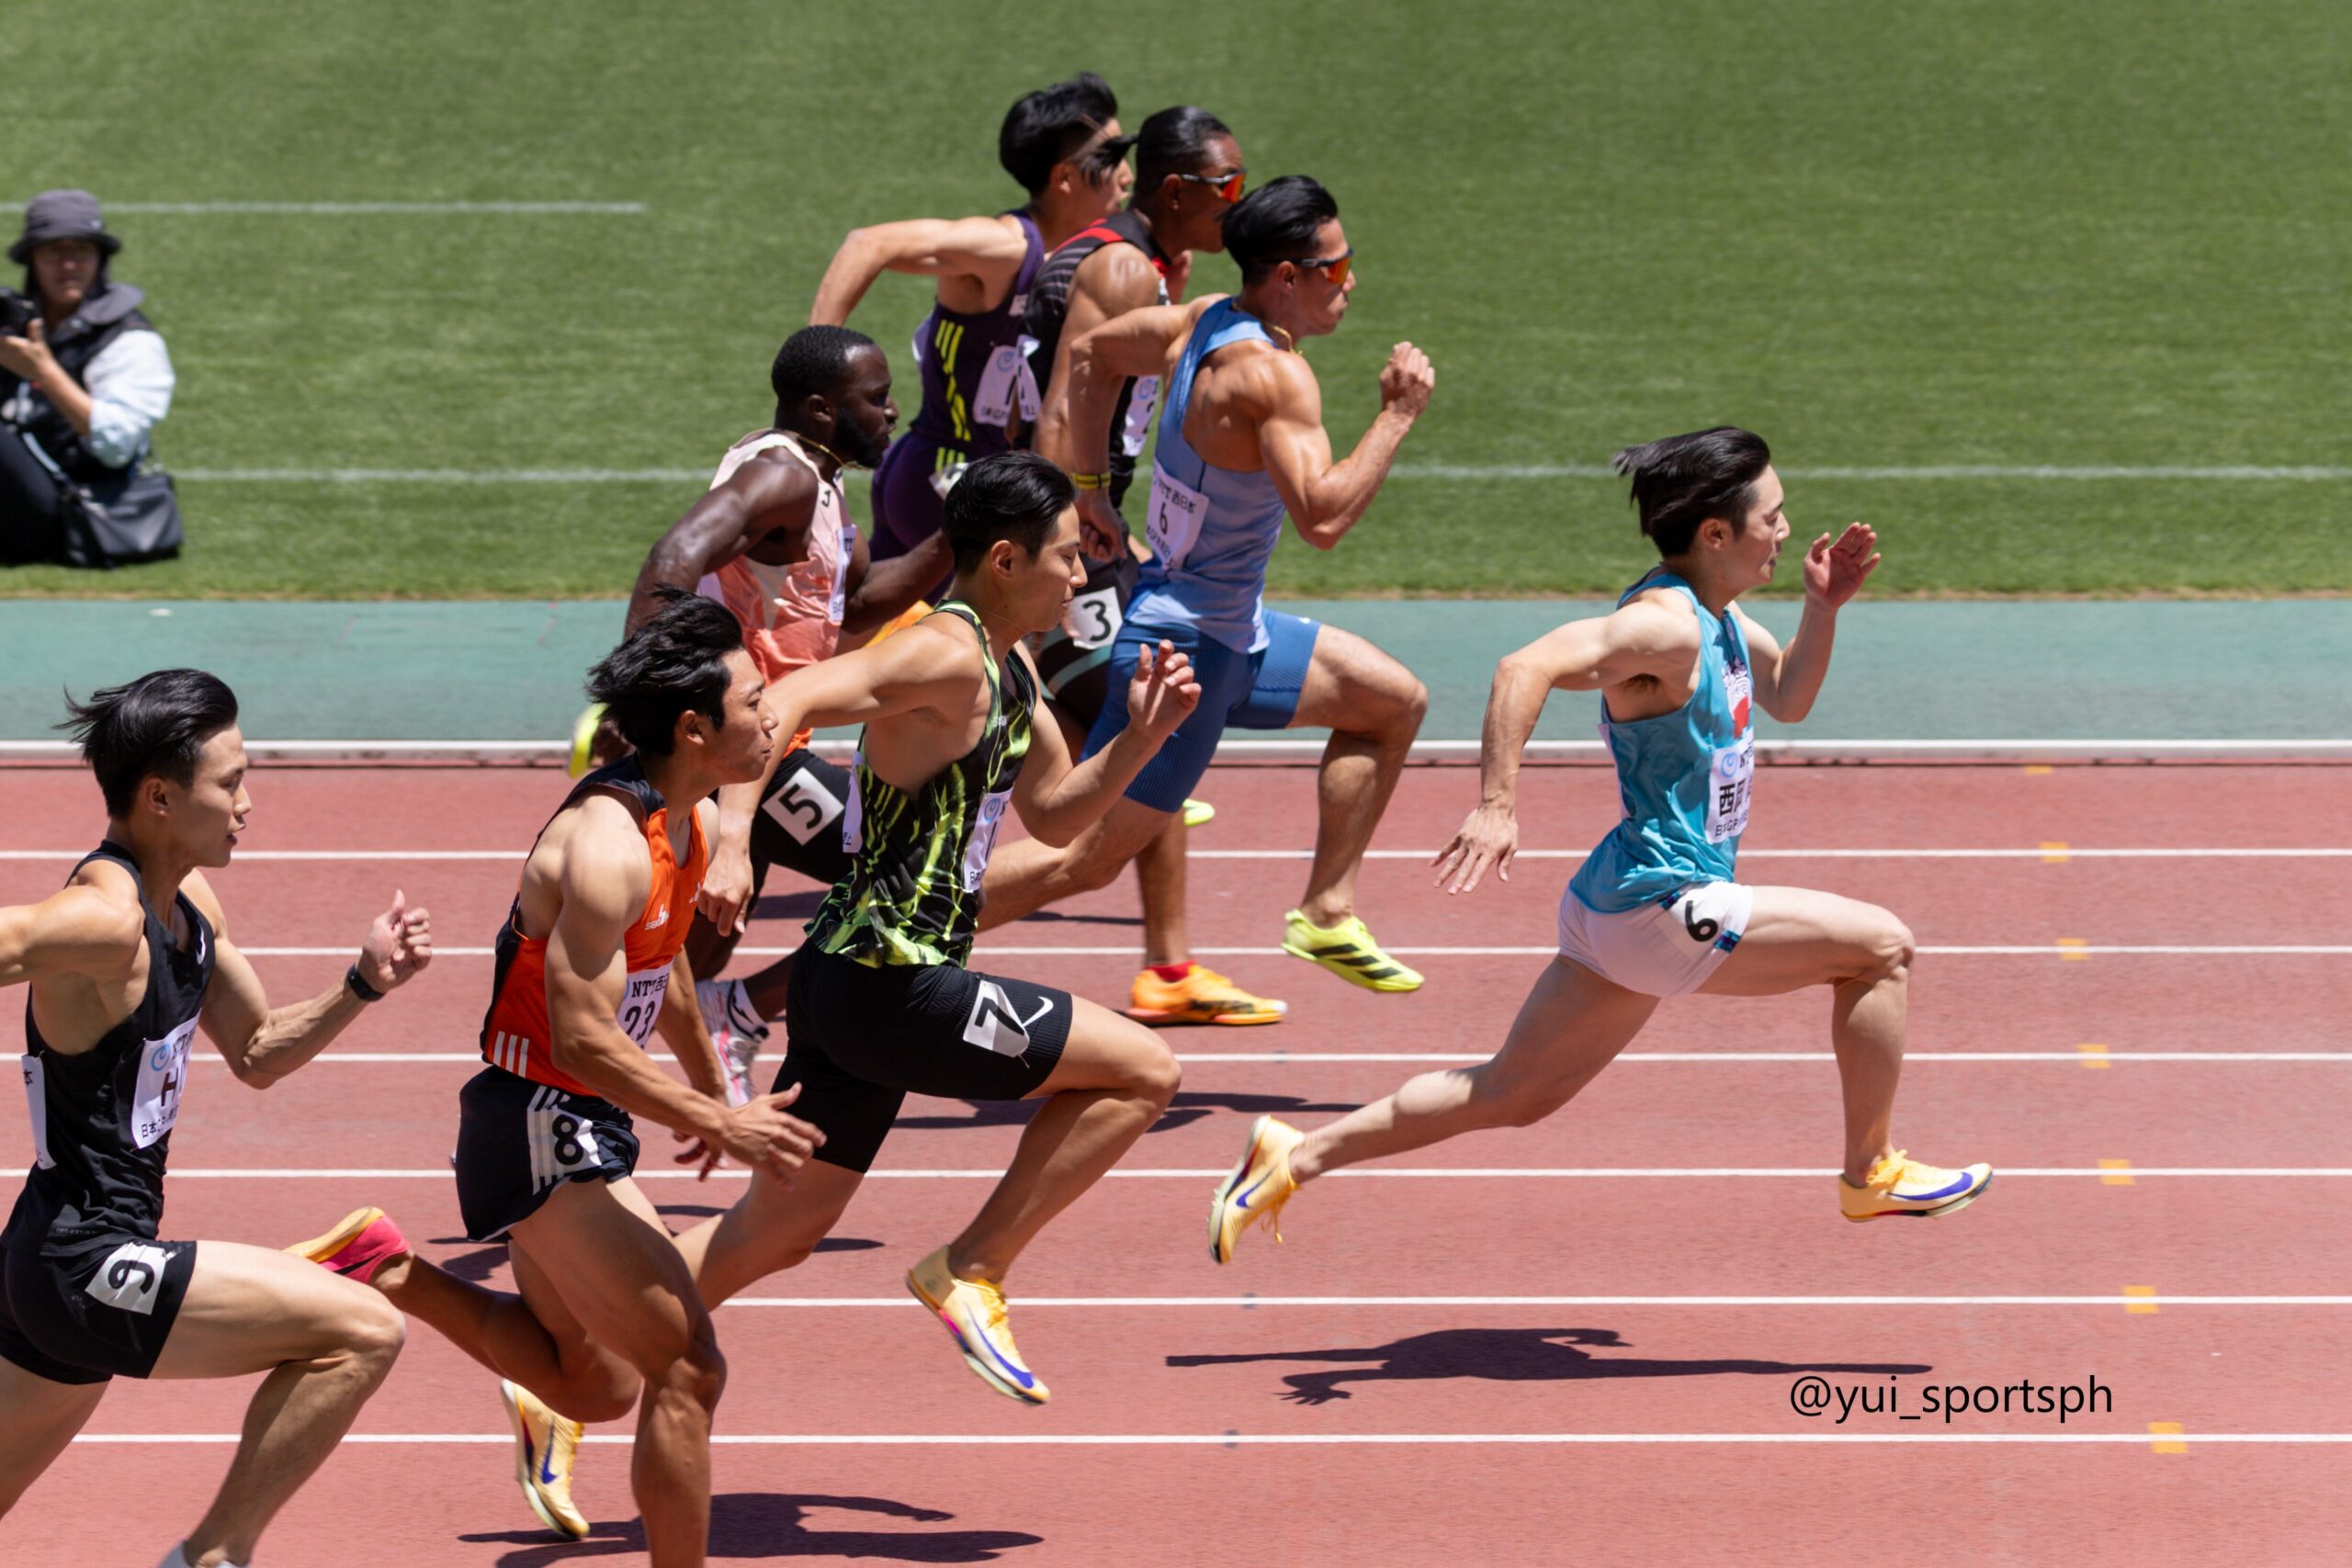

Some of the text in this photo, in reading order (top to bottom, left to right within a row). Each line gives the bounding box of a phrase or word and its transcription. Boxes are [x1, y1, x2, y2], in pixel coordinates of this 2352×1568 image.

[1159, 502, 1169, 536] 6
[1082, 600, 1112, 642] 3
[778, 783, 823, 829] 5
[1685, 900, 1719, 942] 6
[624, 1000, 656, 1042] 23
[974, 997, 1024, 1036] 7
[552, 1114, 584, 1166] 8
[107, 1258, 155, 1294] 9
